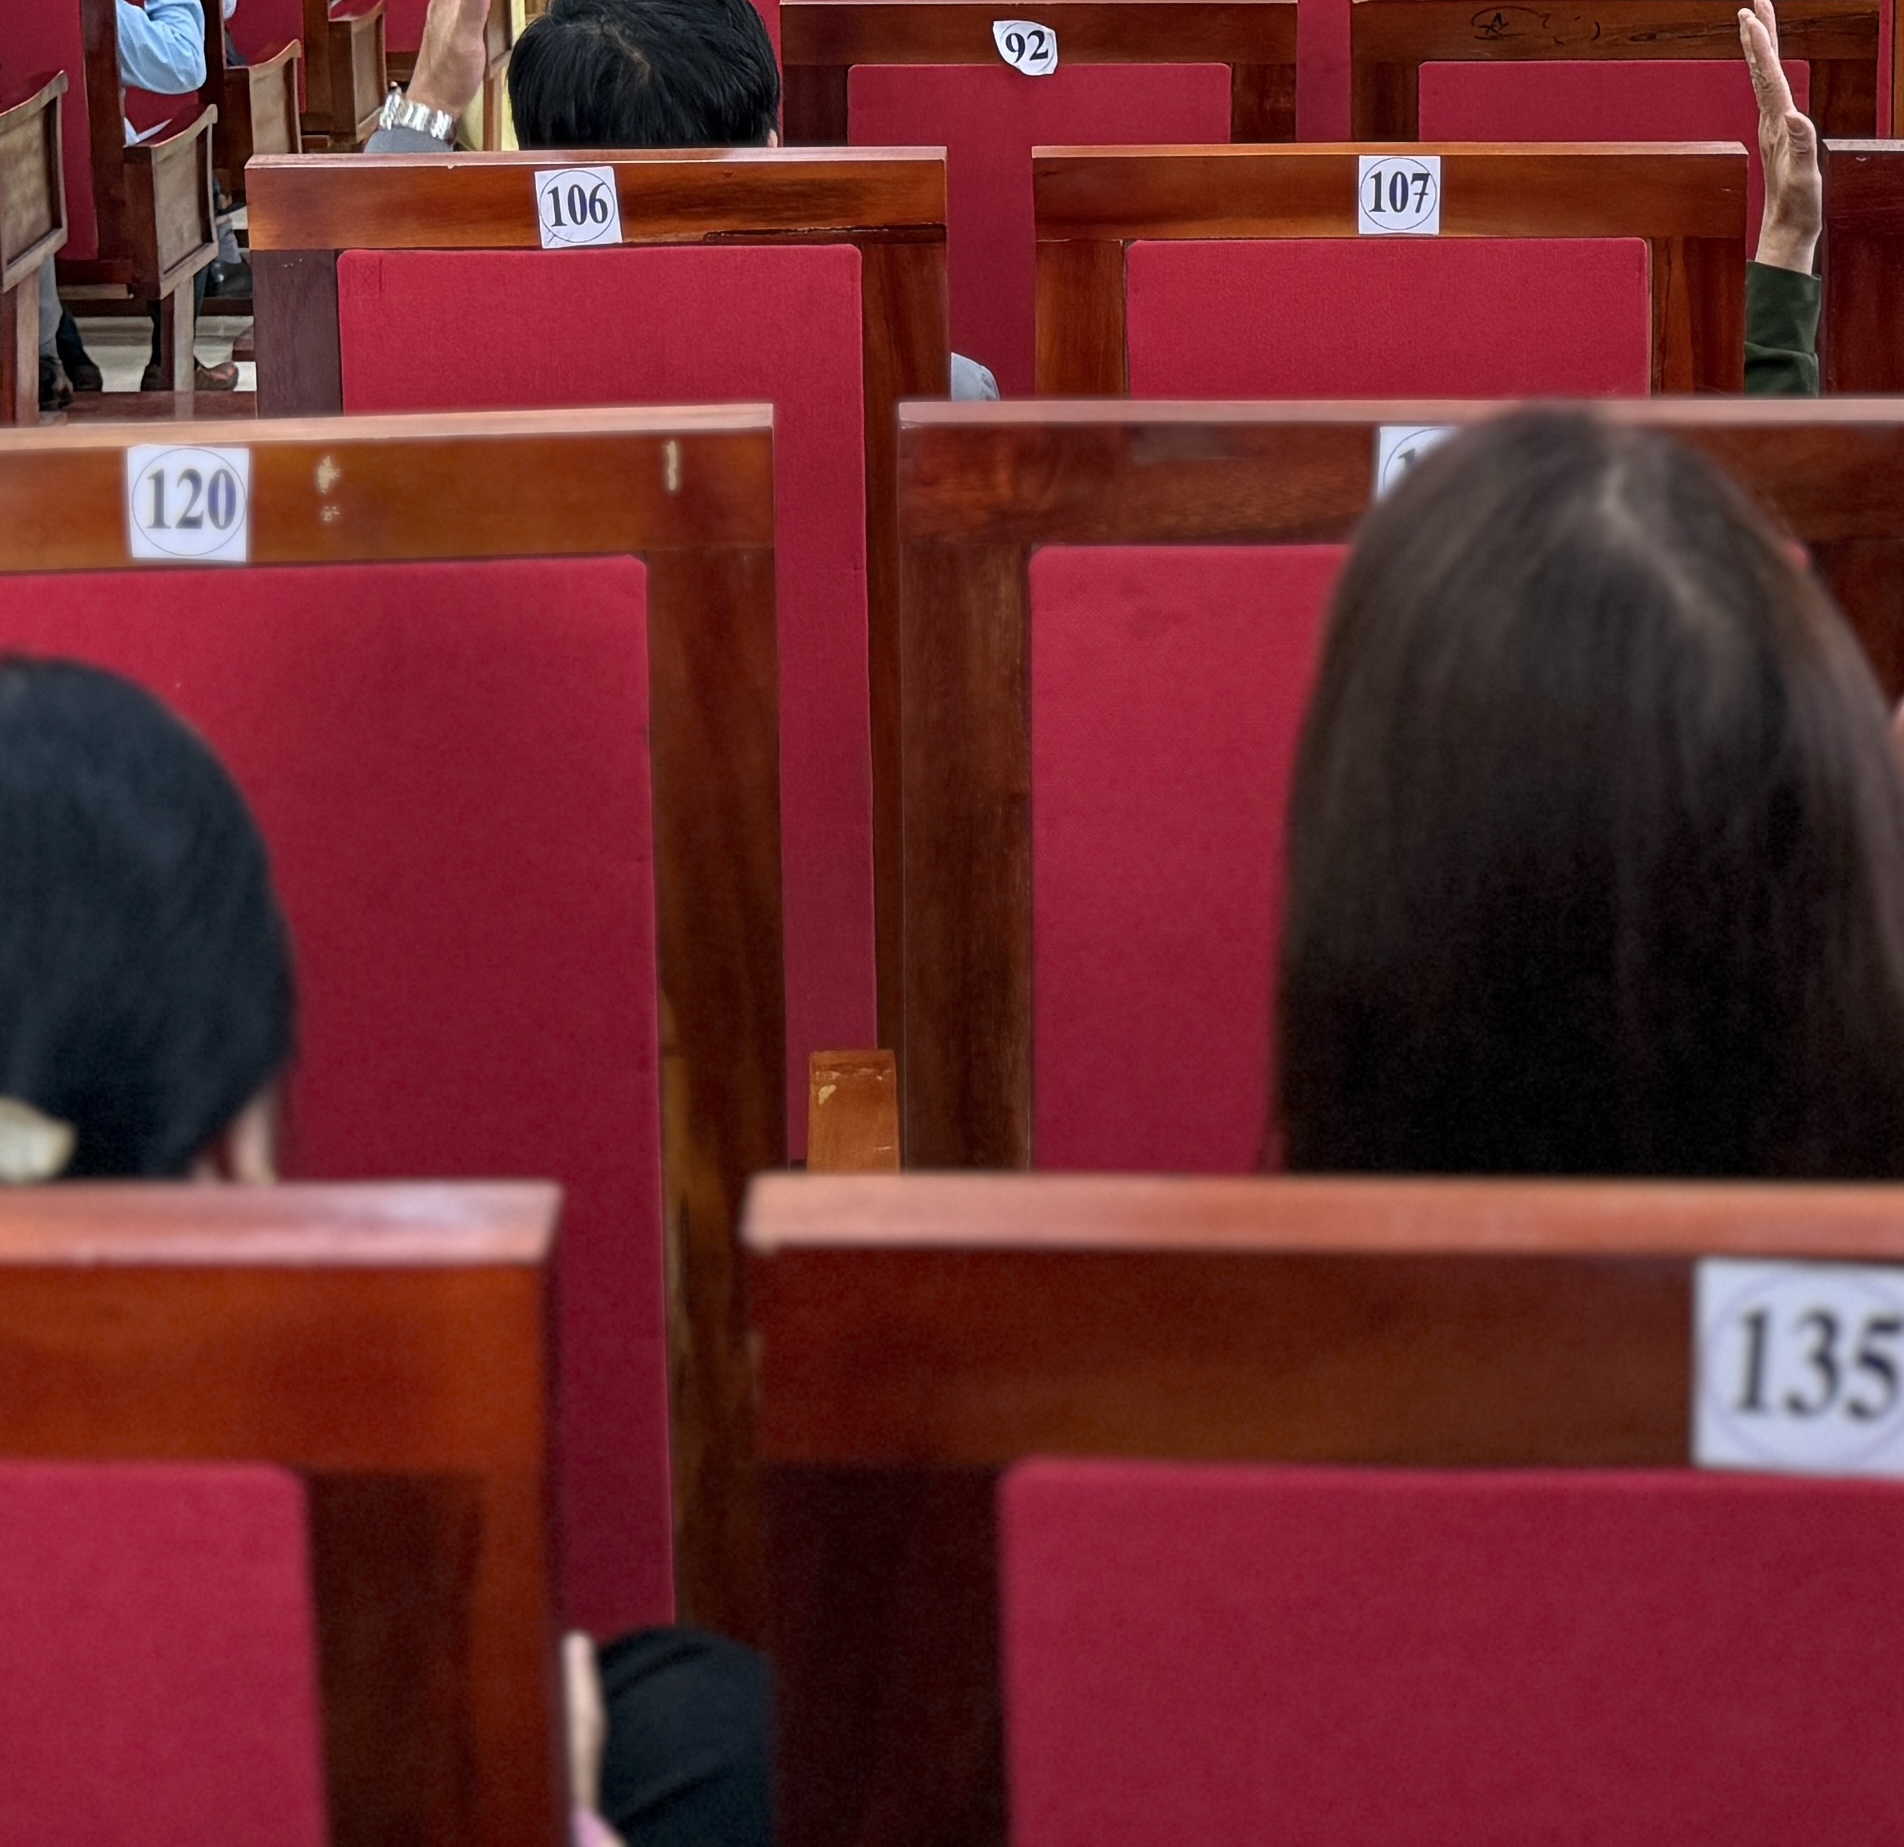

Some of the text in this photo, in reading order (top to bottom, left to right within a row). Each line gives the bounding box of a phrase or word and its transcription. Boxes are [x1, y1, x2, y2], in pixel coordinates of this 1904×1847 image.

[1006, 30, 1048, 62] 92
[548, 181, 611, 227] 106
[1369, 168, 1432, 213] 107
[150, 469, 236, 529] 120
